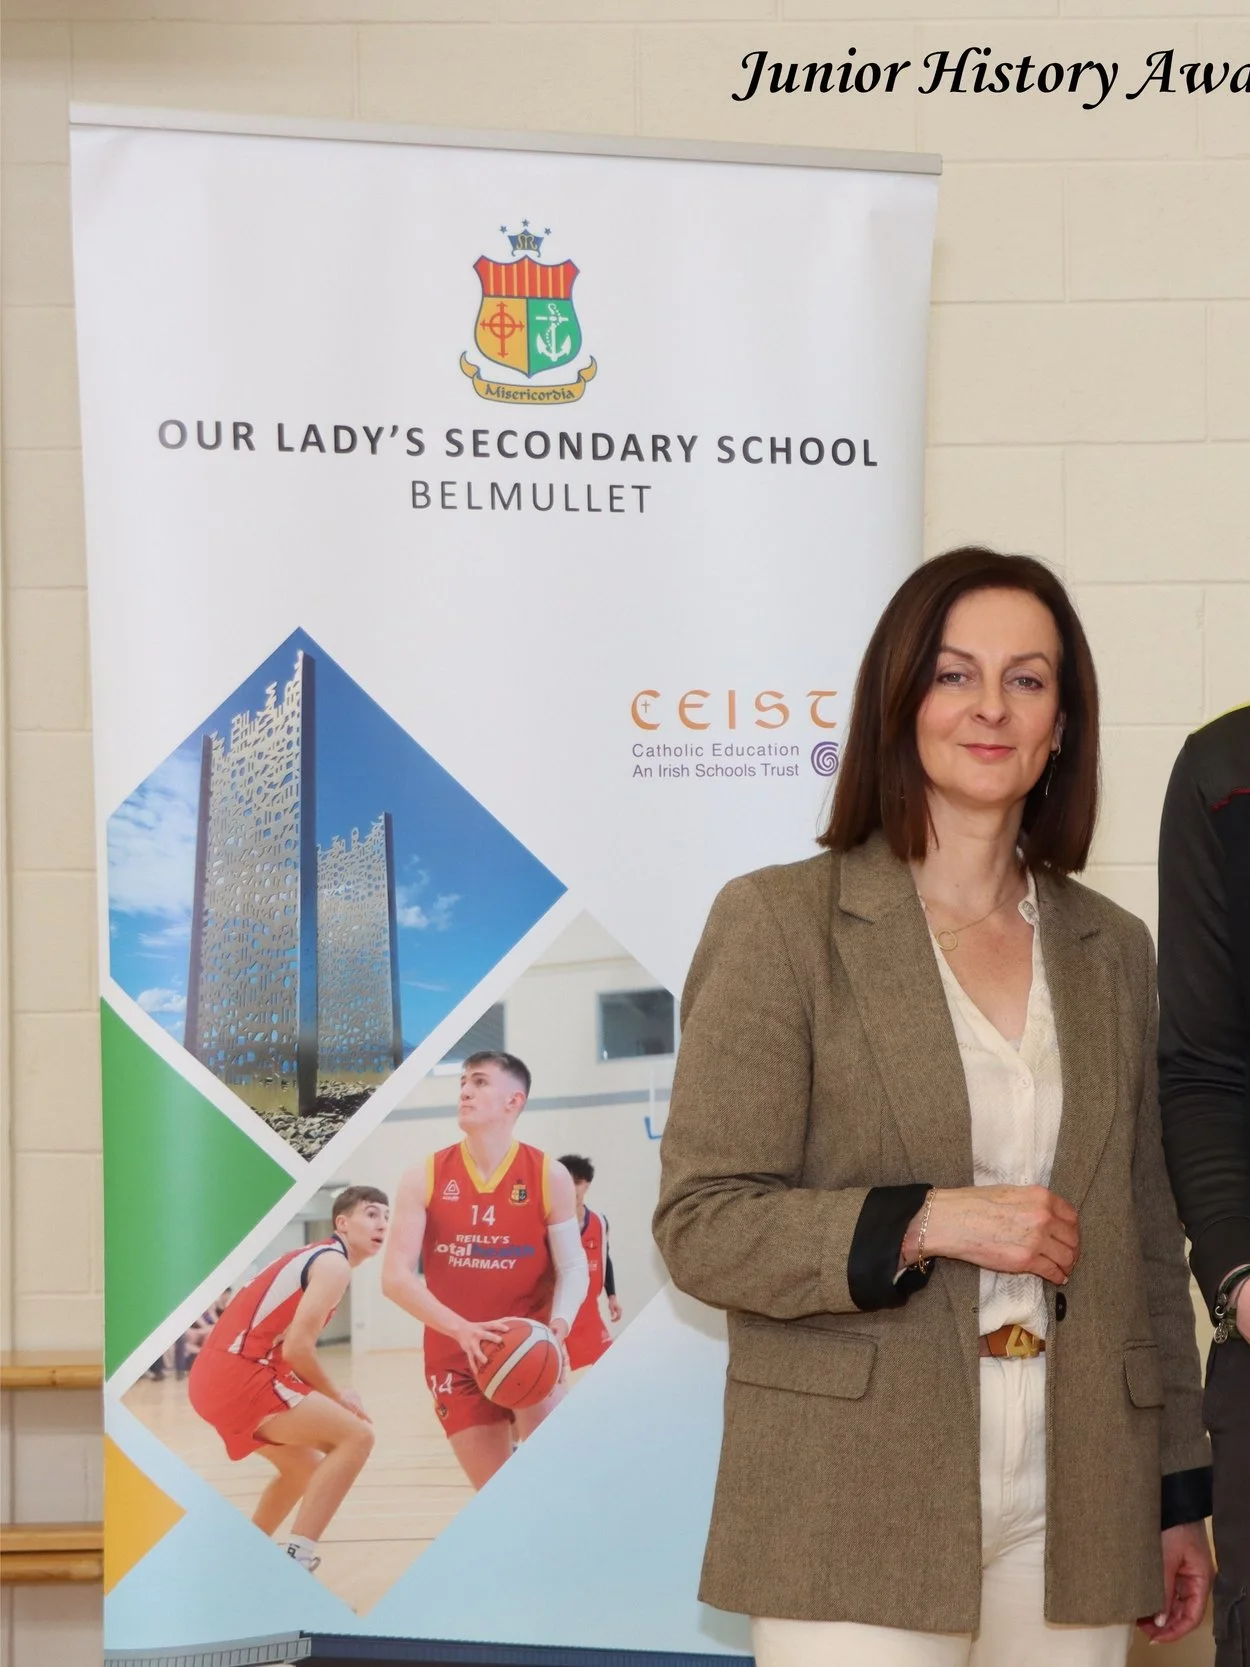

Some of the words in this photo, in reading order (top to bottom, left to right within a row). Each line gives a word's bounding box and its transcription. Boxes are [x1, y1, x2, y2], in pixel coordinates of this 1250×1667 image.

[484, 384, 576, 401] Misericordia
[158, 419, 256, 451] OUR
[445, 428, 698, 463] SECONDARY
[717, 435, 878, 467] SCHOOL
[411, 480, 652, 514] BELMULLET
[631, 689, 838, 731] CEIST
[632, 743, 704, 758] Catholic
[712, 742, 800, 757] Education
[632, 764, 653, 778] An
[658, 763, 690, 778] Irish
[695, 763, 757, 778] Schools
[760, 762, 799, 777] Trust
[471, 1204, 496, 1226] 14
[455, 1234, 511, 1245] REILLY'S
[448, 1255, 517, 1270] PHARMACY
[430, 1372, 453, 1401] 14
